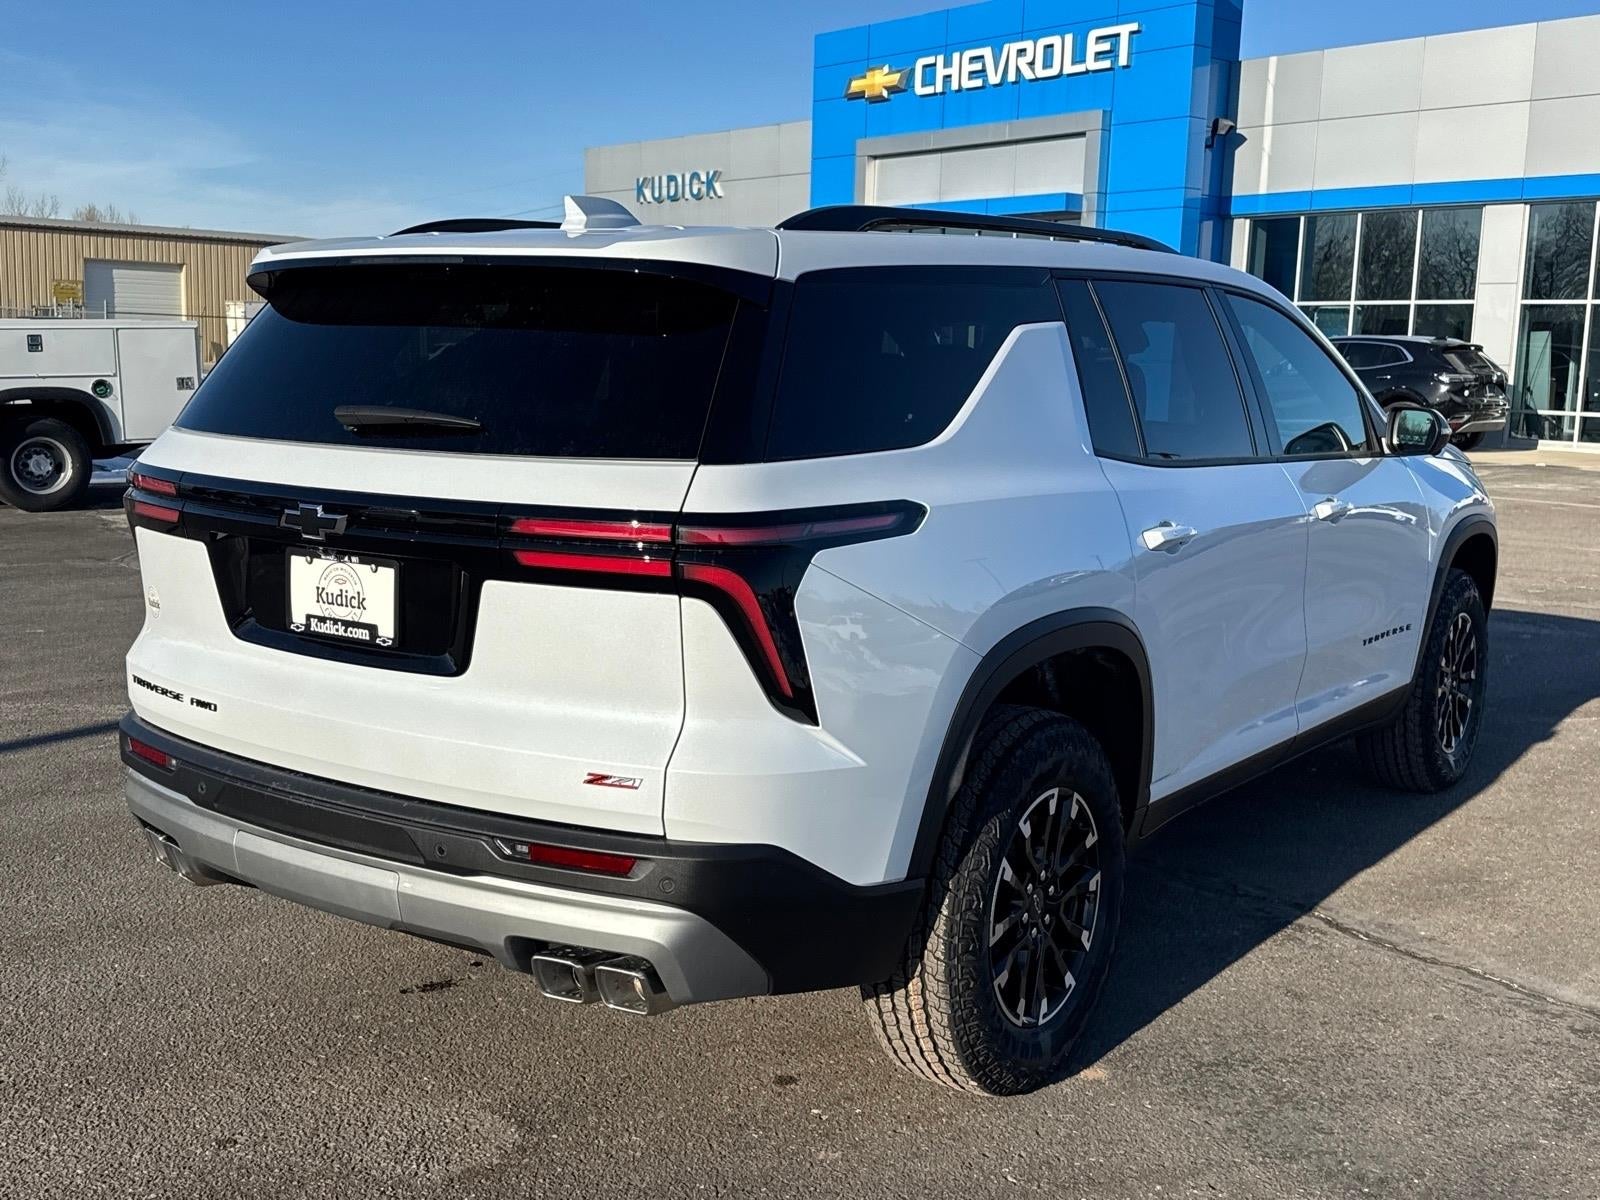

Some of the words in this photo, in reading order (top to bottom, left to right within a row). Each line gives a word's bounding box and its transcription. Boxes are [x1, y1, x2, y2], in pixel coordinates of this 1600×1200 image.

[914, 22, 1141, 97] CHEVROLET
[636, 169, 724, 204] KUDICK
[316, 586, 367, 610] Kudick
[310, 618, 369, 640] Kudick.com
[1362, 623, 1412, 646] TRAVERSE
[132, 674, 184, 702] TRAVERSE
[190, 697, 218, 712] AWD
[583, 772, 644, 790] Z71
